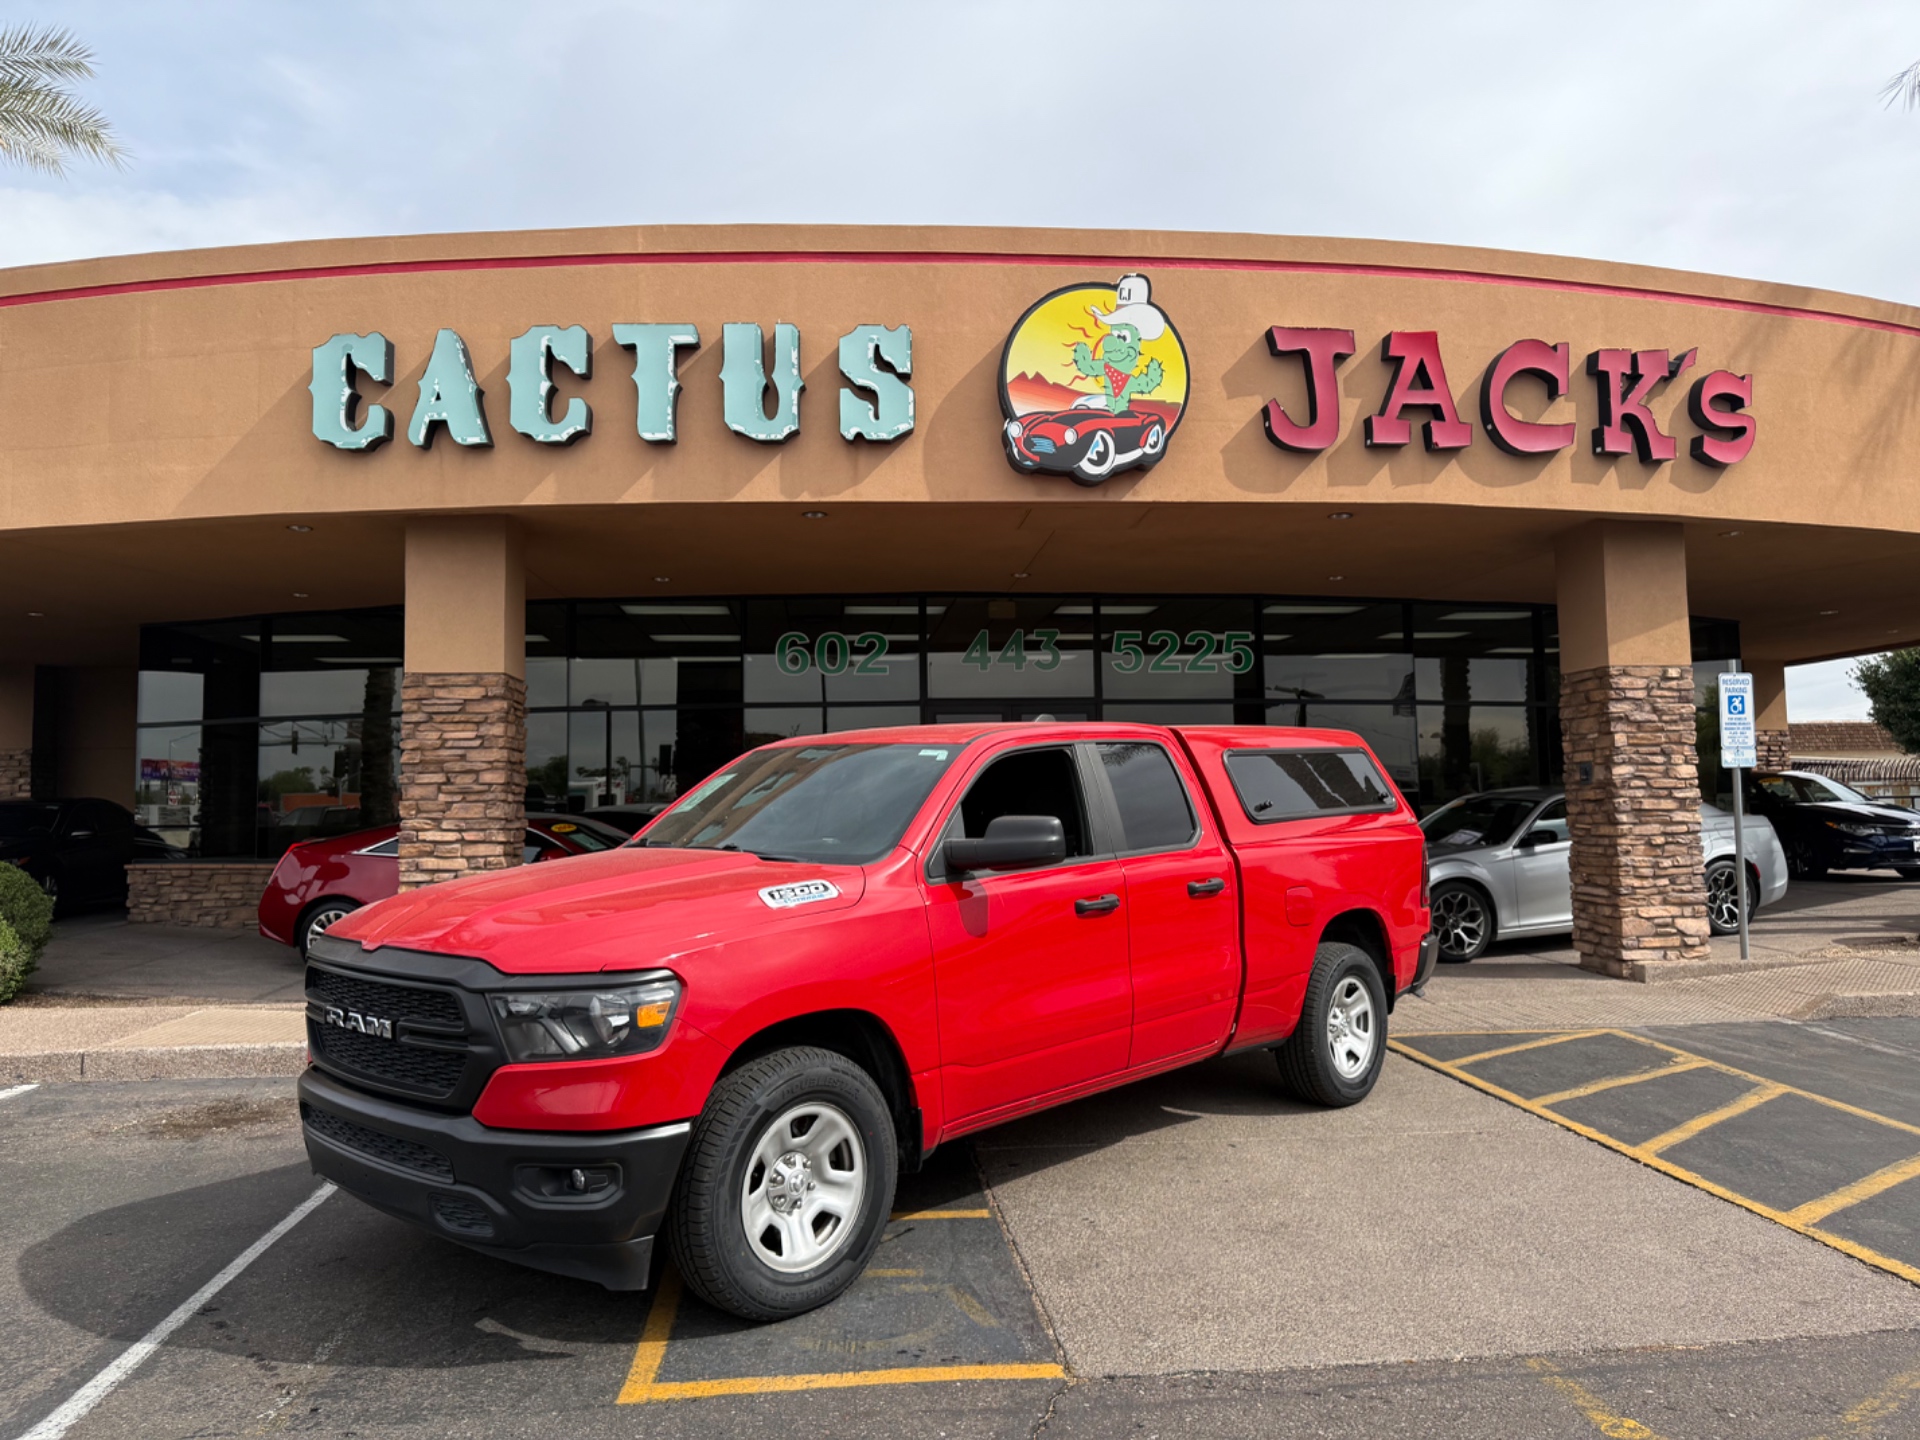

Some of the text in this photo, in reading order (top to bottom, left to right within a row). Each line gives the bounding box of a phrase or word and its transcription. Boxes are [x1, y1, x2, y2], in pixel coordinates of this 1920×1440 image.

[1119, 287, 1131, 301] CJ
[308, 322, 914, 453] CACTUS
[775, 628, 1254, 675] 602 443 5225
[1721, 678, 1749, 686] RESERVED
[772, 883, 825, 899] 1500
[325, 1005, 393, 1040] RAM
